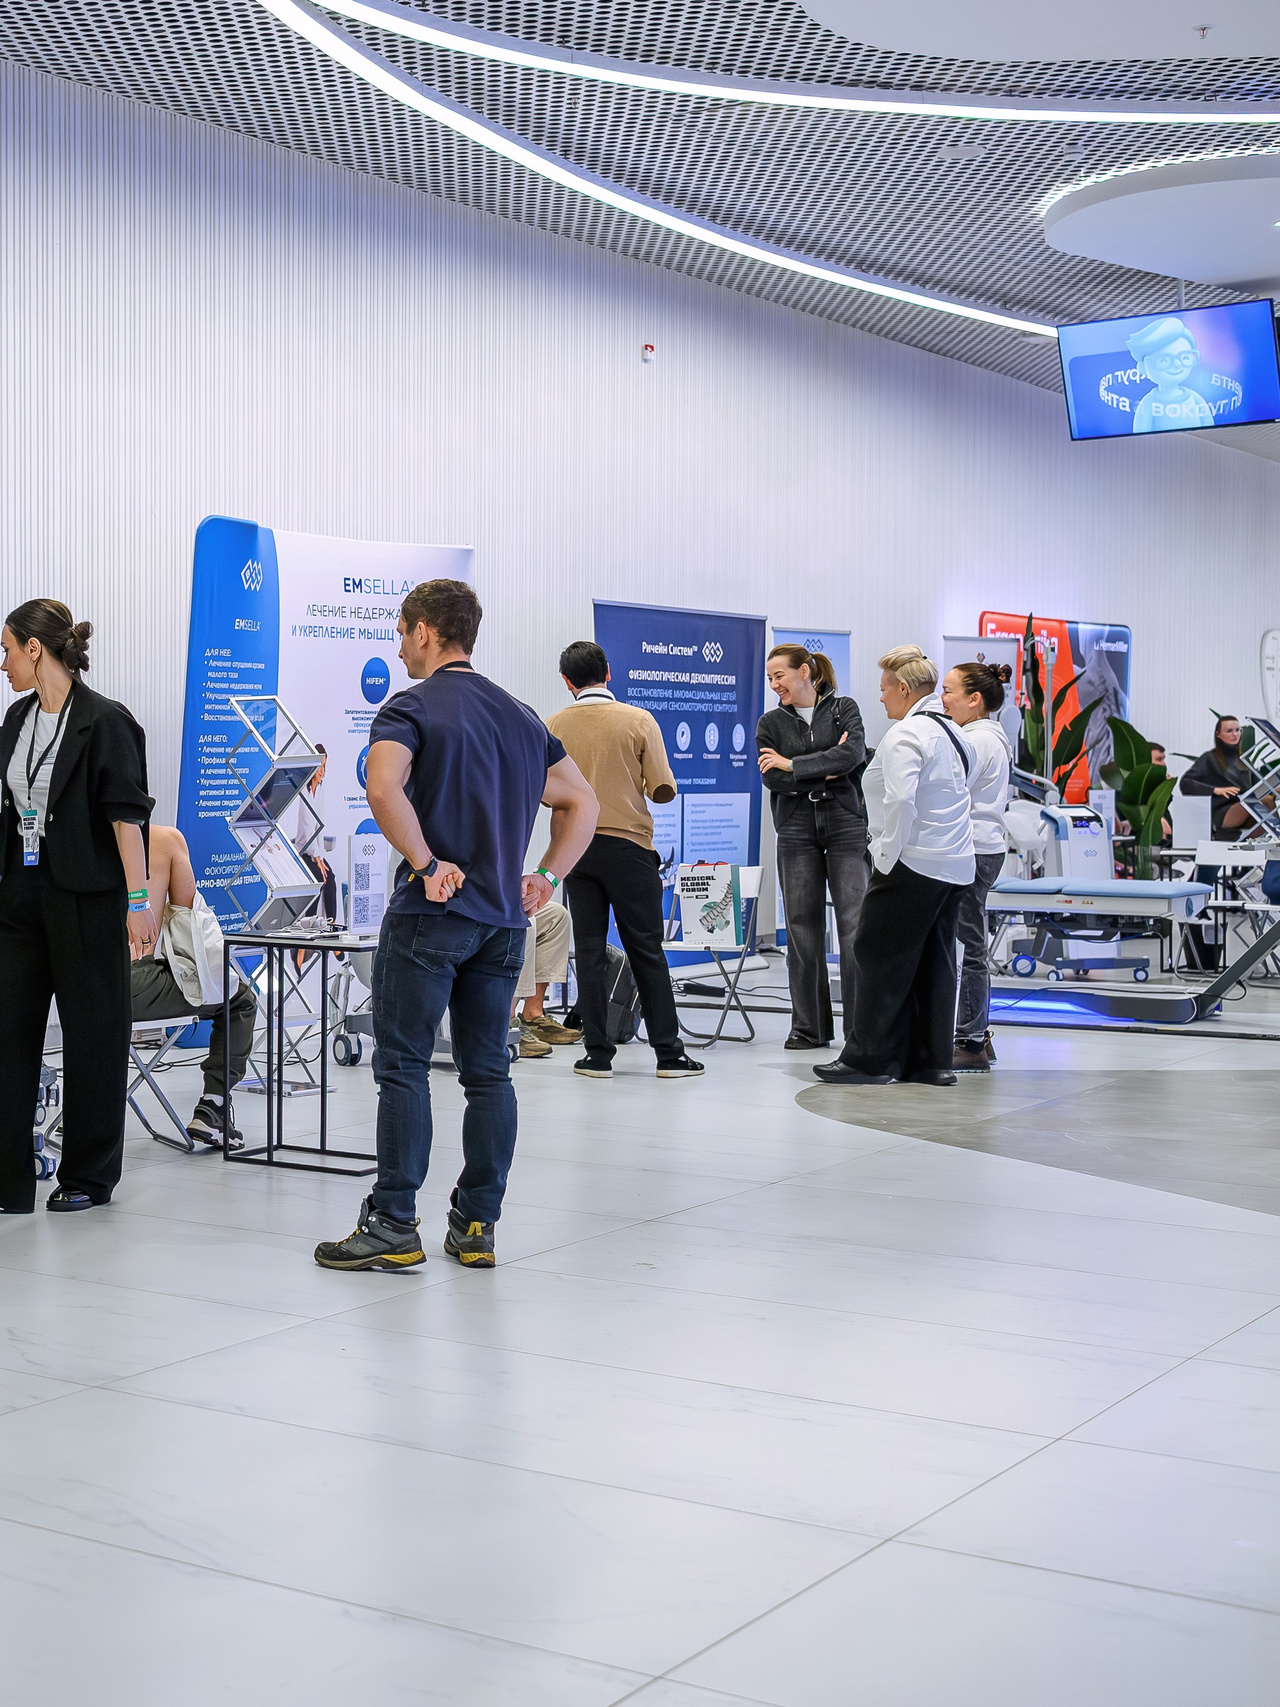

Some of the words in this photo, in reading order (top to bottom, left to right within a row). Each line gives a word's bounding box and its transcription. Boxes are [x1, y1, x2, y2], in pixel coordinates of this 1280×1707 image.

[306, 604, 348, 618] ЛЕЧЕНИЕ
[349, 606, 402, 621] НЕДЕРЖА
[291, 625, 297, 636] И
[298, 625, 355, 640] УКРЕПЛЕНИЕ
[358, 628, 395, 642] МЫШЦ
[204, 648, 219, 657] ДЛЯ
[642, 641, 668, 655] Ричейн
[628, 669, 690, 683] ФИЗИОЛОГИЧЕСКАЯ
[198, 735, 212, 743] ДЛЯ
